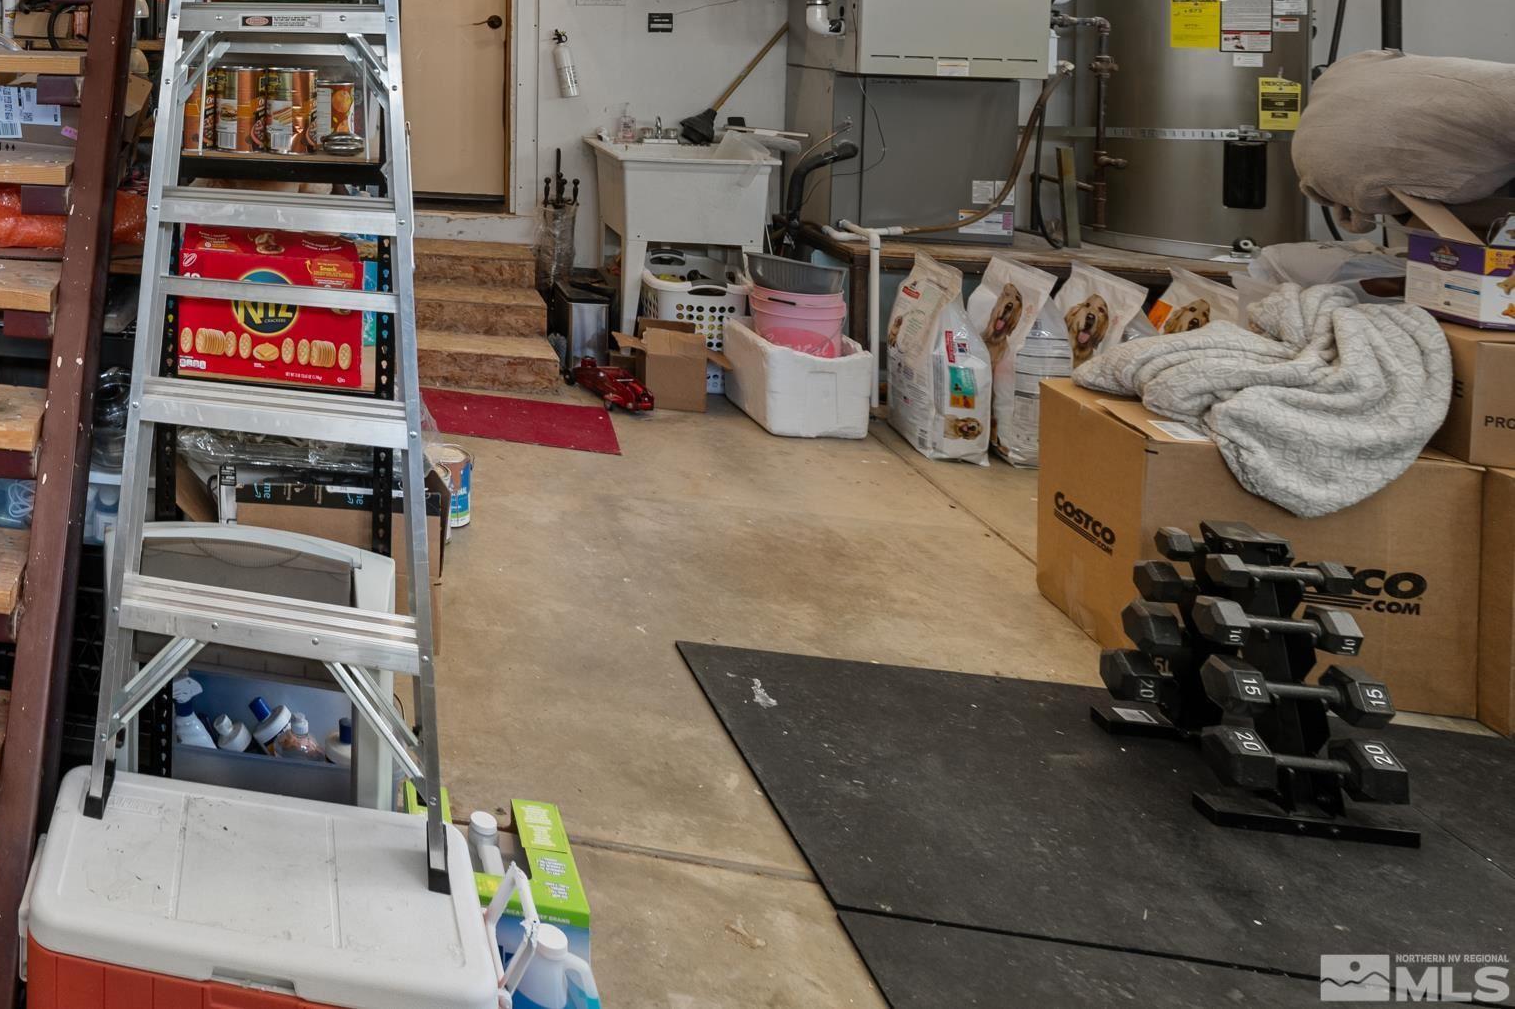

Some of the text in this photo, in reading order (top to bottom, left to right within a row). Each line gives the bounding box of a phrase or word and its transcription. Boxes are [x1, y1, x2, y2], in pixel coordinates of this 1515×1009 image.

[1054, 492, 1116, 546] COSTCO
[1139, 678, 1156, 699] 20
[1242, 678, 1262, 697] 15
[1366, 687, 1387, 707] 15
[1235, 730, 1263, 753] 20
[1365, 744, 1394, 766] 20
